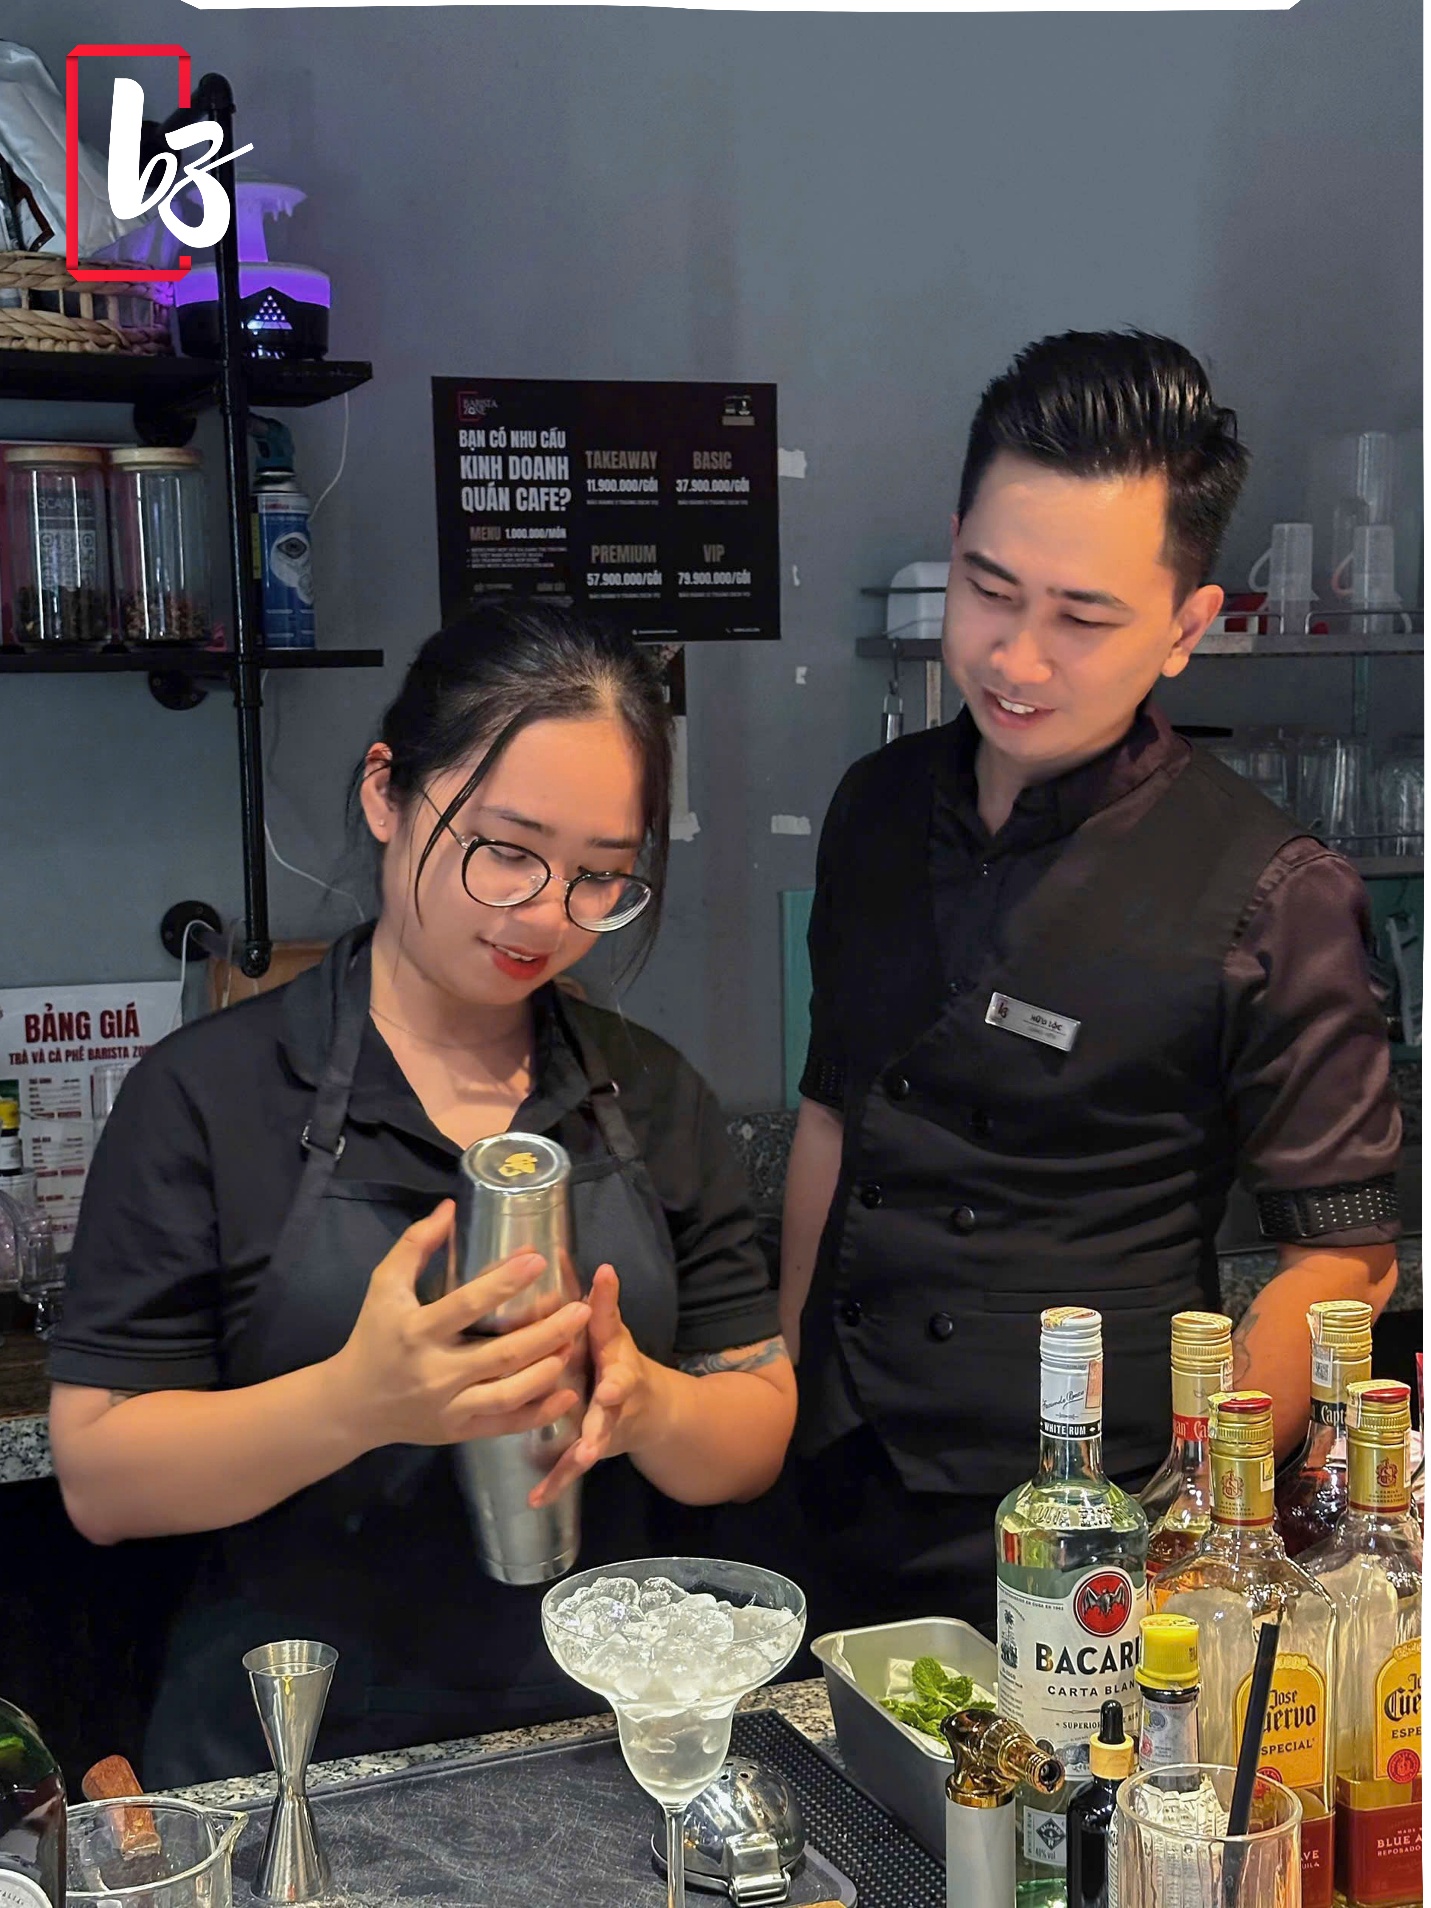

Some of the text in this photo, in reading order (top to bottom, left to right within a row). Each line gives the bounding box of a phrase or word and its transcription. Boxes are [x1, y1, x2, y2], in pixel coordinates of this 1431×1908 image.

[459, 429, 486, 451] BẠN
[489, 426, 507, 448] CÓ
[510, 430, 537, 448] NHU
[460, 455, 569, 480] KINH DOANH
[585, 450, 658, 470] TAKEAWAY
[692, 451, 733, 470] BASIC
[461, 481, 572, 513] QUÁN CAFE?
[591, 544, 657, 564] PREMIUM
[703, 544, 726, 563] VIP
[25, 1002, 140, 1044] BẢNG GIÁ
[88, 1046, 130, 1061] BARISTA
[1321, 1405, 1345, 1427] Capt
[1044, 1424, 1086, 1435] WHITE RUM
[1035, 1636, 1140, 1675] BACAR
[1047, 1680, 1135, 1697] CARTA BLAN
[1269, 1689, 1298, 1710] Jose
[1384, 1687, 1421, 1721] Cue
[1062, 1721, 1100, 1730] SUPERIO
[1263, 1704, 1317, 1733] uervo
[1391, 1726, 1421, 1739] ESPE
[1261, 1739, 1313, 1756] SPECIAL
[1377, 1835, 1410, 1848] BLUE
[1302, 1861, 1320, 1870] UILA
